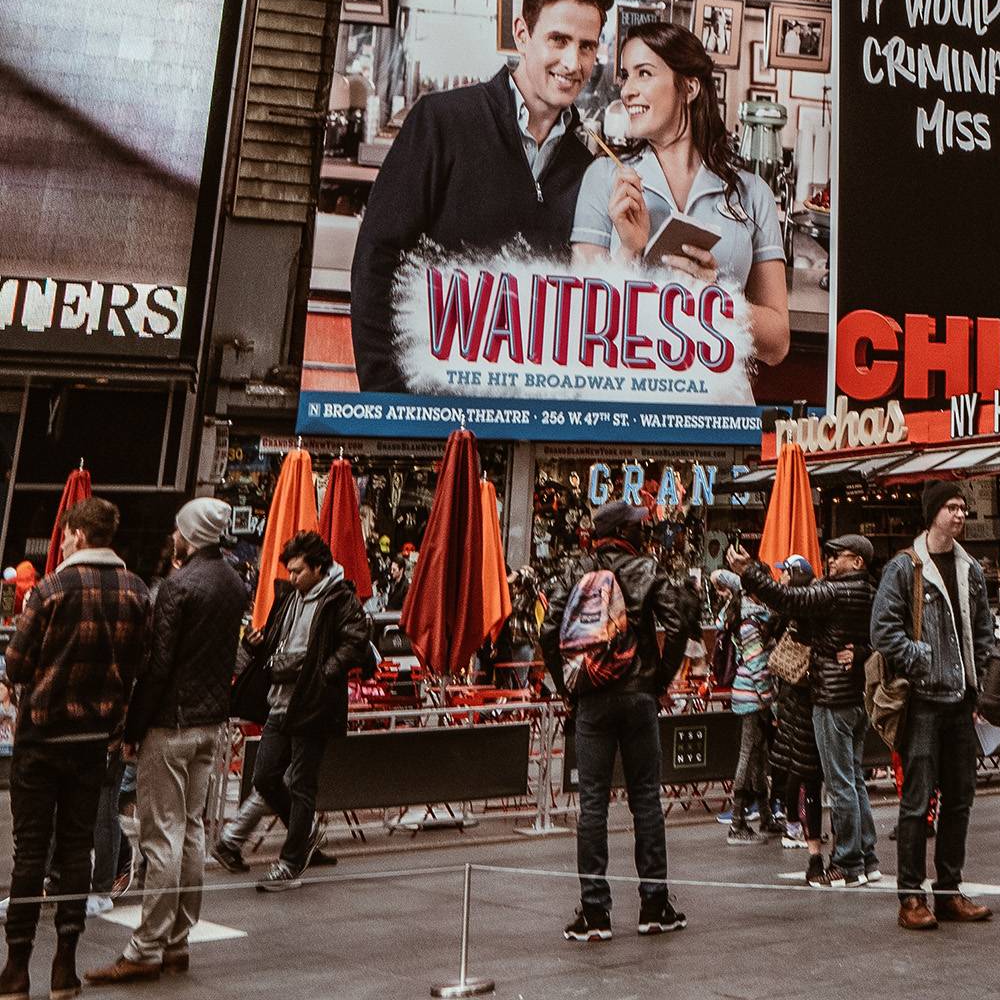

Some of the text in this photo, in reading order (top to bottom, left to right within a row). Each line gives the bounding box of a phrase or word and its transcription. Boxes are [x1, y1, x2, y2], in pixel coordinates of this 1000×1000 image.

[916, 98, 992, 155] MISS
[426, 266, 735, 373] WAITRESS
[447, 370, 708, 393] THE HIT BROADWAY MUSICAL
[323, 404, 382, 419] BROOKS
[385, 405, 463, 422] ATKINSON
[466, 408, 530, 424] THEATRE
[541, 410, 564, 425] 256
[568, 411, 582, 426] W.
[584, 411, 610, 427] 47TH
[613, 413, 630, 427] ST.
[950, 392, 977, 438] NY
